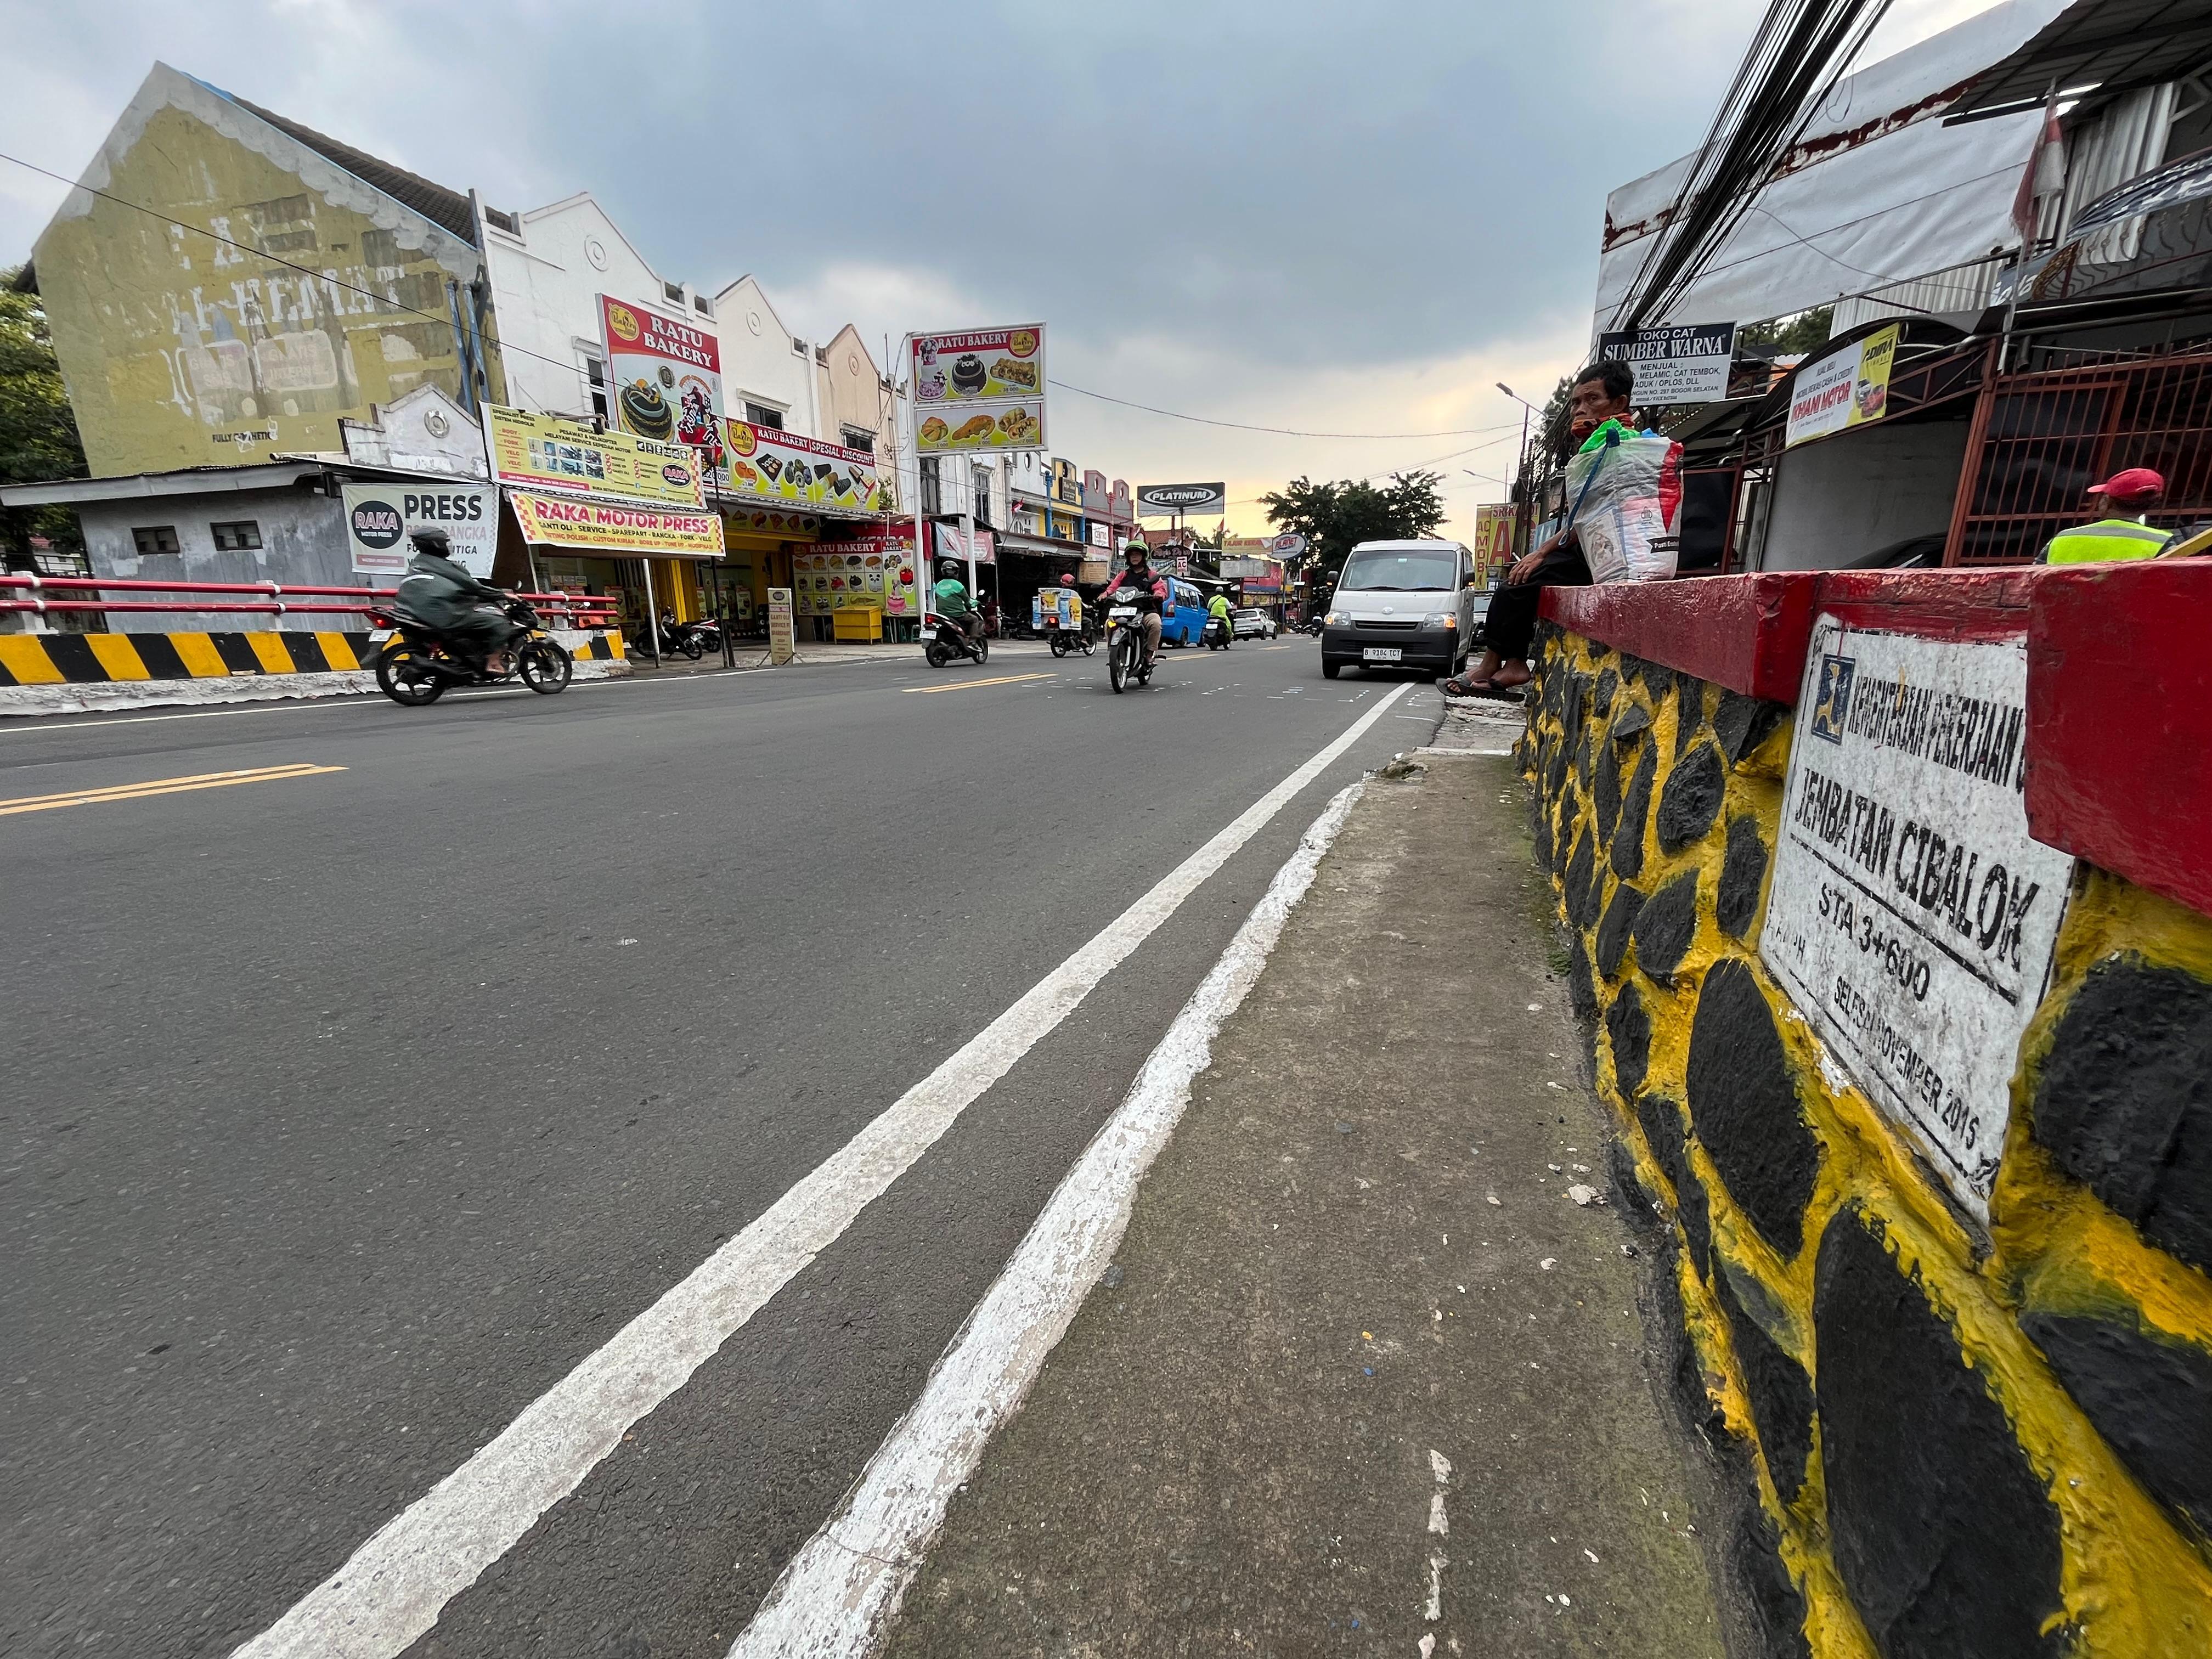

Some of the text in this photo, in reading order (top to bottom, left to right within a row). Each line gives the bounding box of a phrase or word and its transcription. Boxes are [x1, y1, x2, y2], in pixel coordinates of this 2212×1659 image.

[650, 316, 702, 347] RATU
[938, 332, 1008, 348] RATU BAKERY
[1637, 328, 1697, 341] TOKO CAT
[642, 332, 713, 368] BAKERY
[1604, 336, 1723, 361] SUMBER WARNA
[1639, 371, 1672, 379] MELAMIC,
[1690, 368, 1720, 376] TEMBOK,
[1821, 381, 1851, 411] MOTOR
[212, 433, 232, 443] FULLY
[758, 428, 874, 465] RATU BAKERY SPESIAL DISCOUNT
[664, 467, 689, 481] RAKA
[404, 494, 482, 520] PRESS
[1153, 492, 1207, 500] PLATINUM
[355, 512, 398, 530] RAKA
[535, 500, 709, 534] RAKA MOTOR PRESS
[539, 522, 559, 530] GANTI
[612, 529, 647, 537] SPAREPART
[810, 543, 876, 553] RATU BAKERY
[1932, 693, 2023, 788] PEKERJAAN
[1795, 768, 2040, 973] JEMBATAN CIBALOK
[1819, 883, 1853, 939] STA
